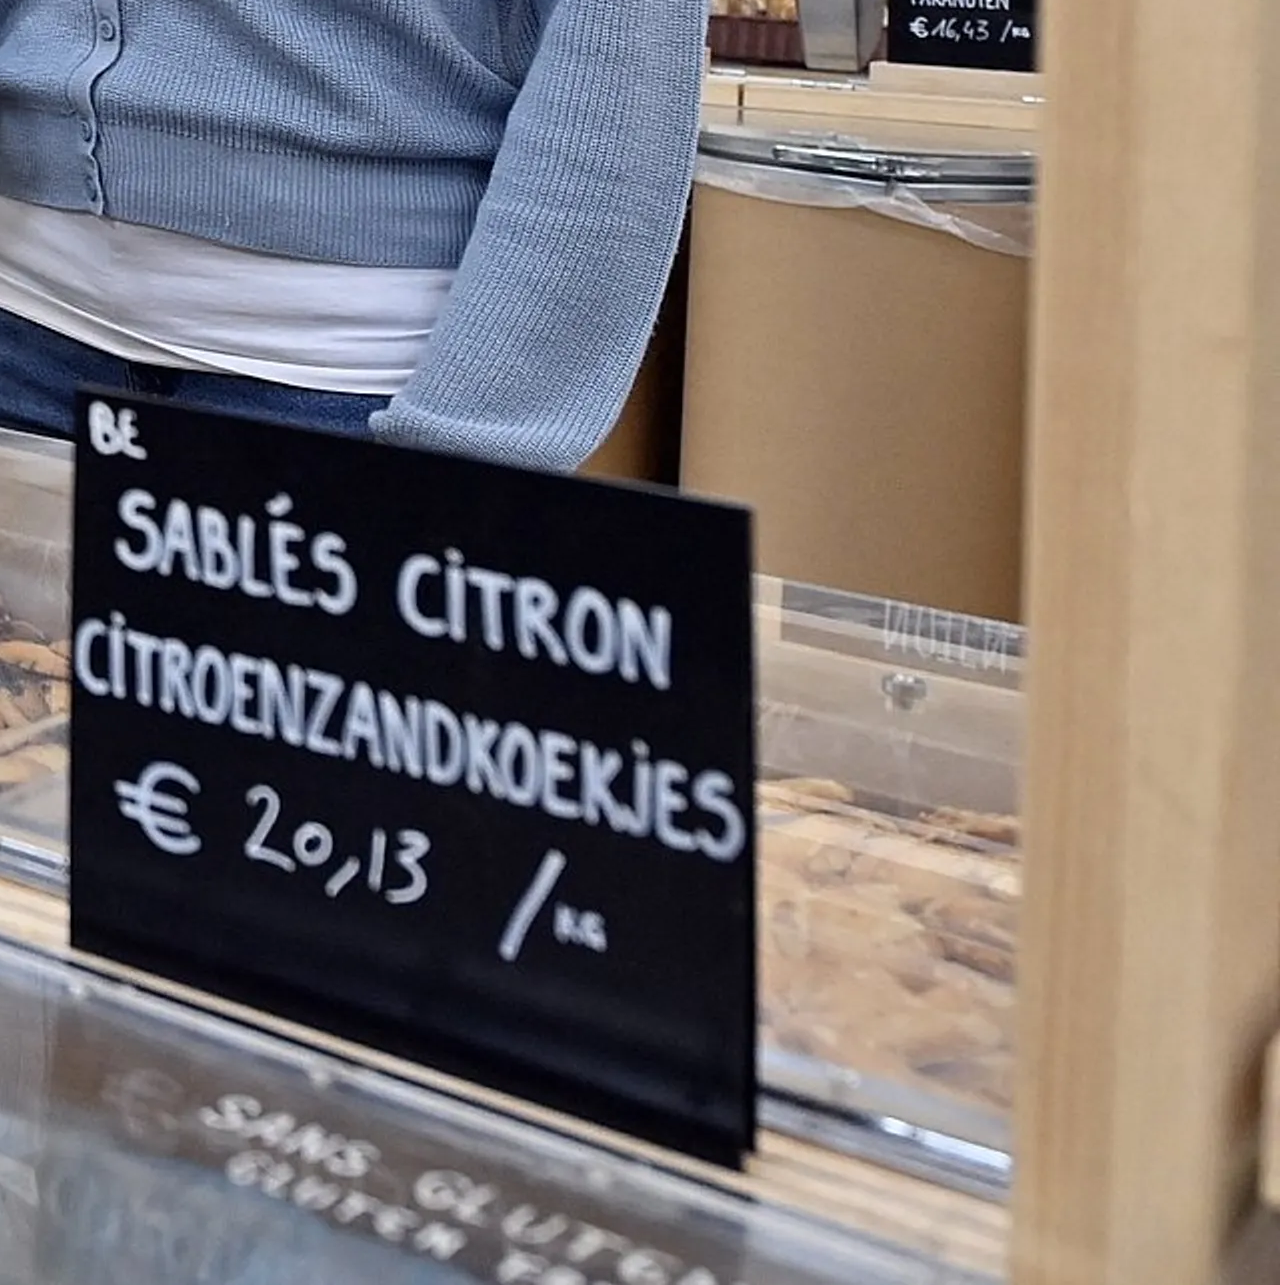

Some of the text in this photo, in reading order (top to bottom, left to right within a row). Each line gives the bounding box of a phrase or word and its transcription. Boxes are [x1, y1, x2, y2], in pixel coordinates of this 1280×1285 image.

[88, 399, 148, 461] BE
[113, 492, 358, 615] SABLÉS
[244, 785, 433, 904] 20,13
[198, 1093, 382, 1179] SANS
